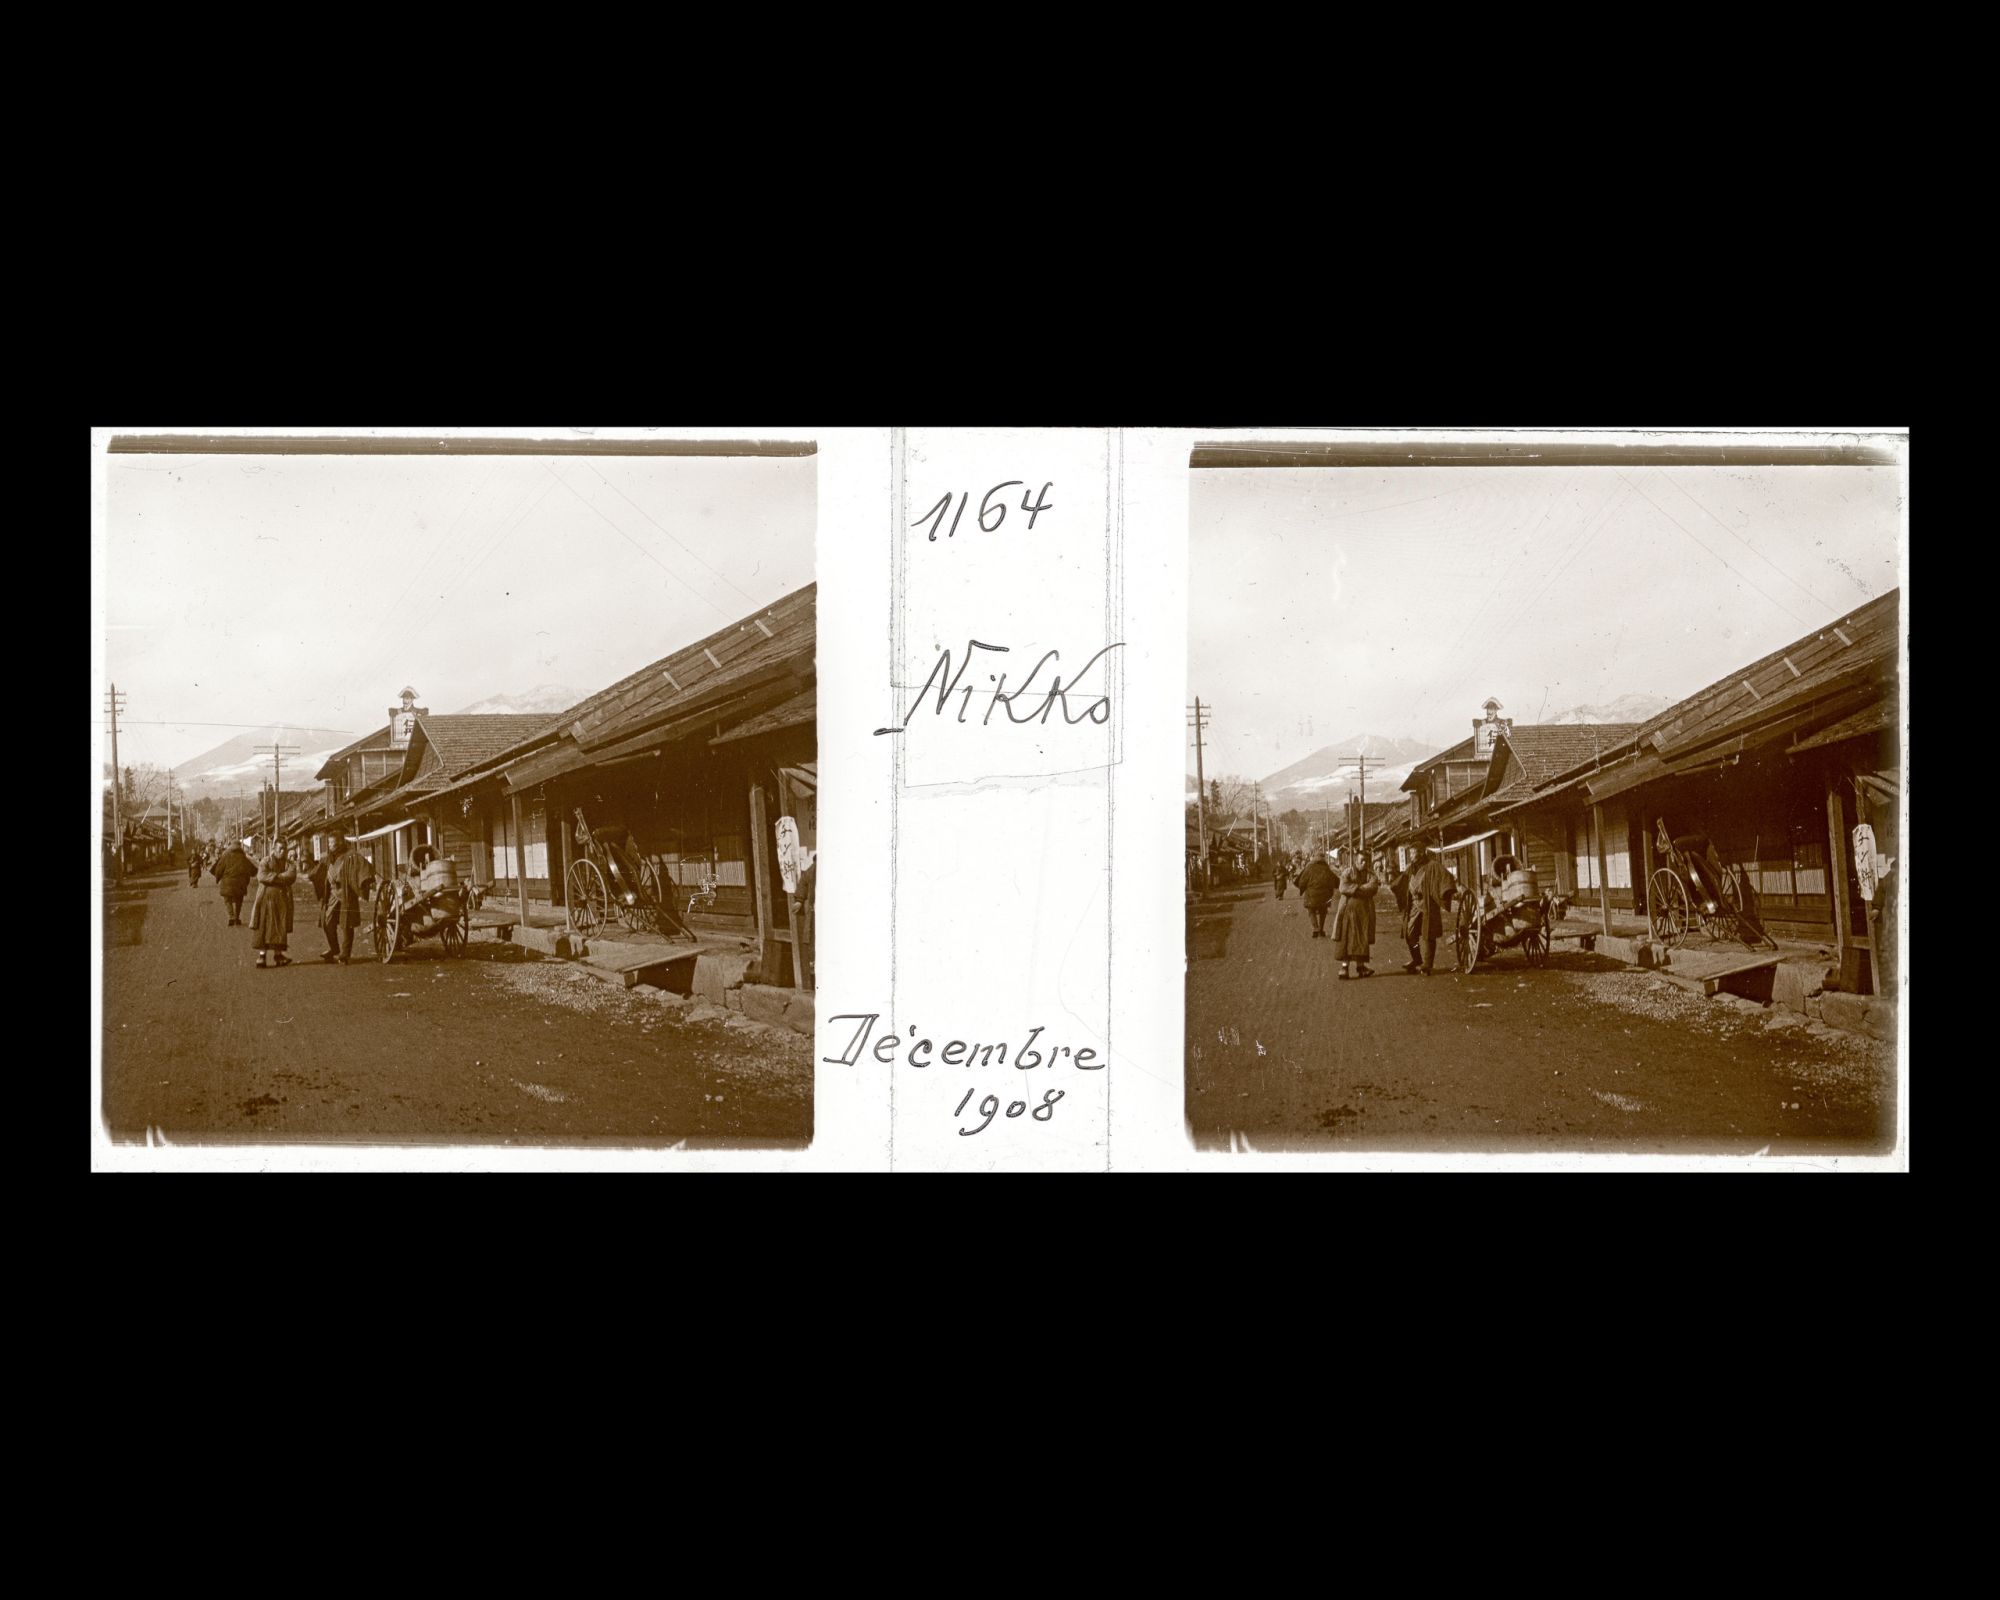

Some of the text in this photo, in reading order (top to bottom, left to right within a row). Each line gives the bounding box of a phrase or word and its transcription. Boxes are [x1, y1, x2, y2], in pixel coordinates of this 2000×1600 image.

[911, 480, 1053, 541] 1164
[823, 1013, 1105, 1070] Décembre
[954, 1087, 1066, 1137] 1908
